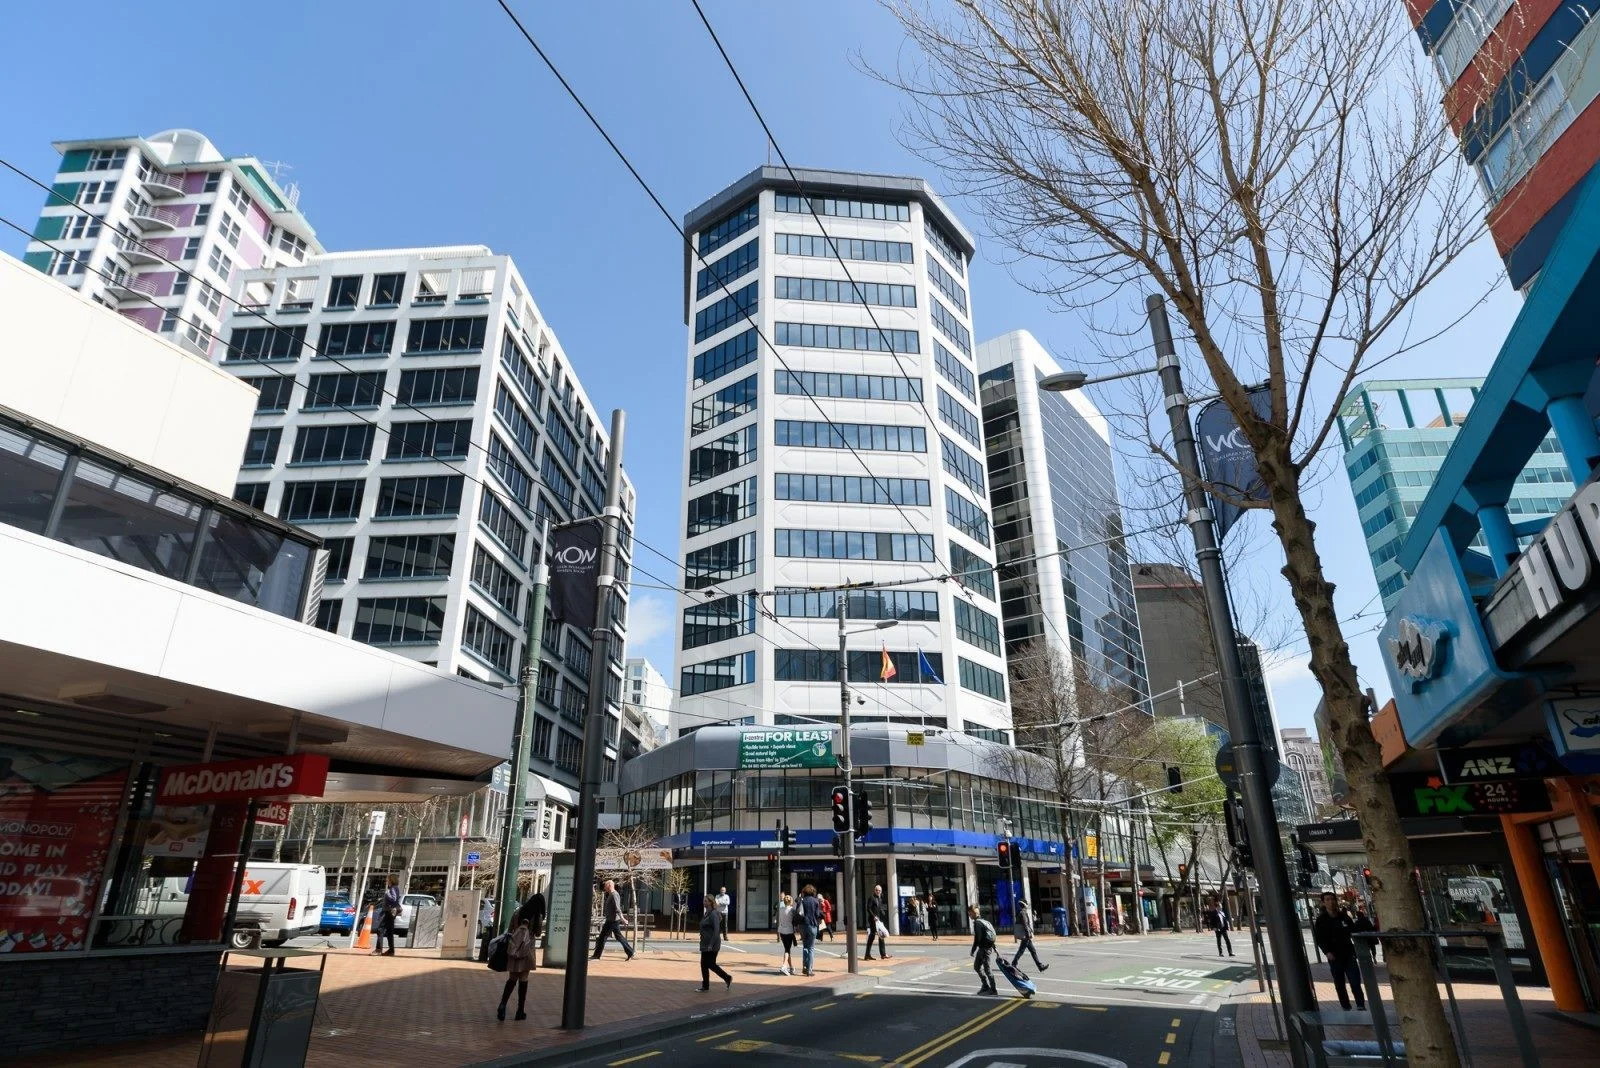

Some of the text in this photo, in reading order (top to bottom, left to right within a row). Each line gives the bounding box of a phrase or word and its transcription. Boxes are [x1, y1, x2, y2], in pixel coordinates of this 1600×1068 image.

[1205, 426, 1252, 453] WO
[765, 732, 793, 742] FOR
[1460, 756, 1516, 777] ANZ
[162, 762, 294, 797] McDonald's
[1484, 783, 1506, 797] 24
[257, 802, 287, 821] ald's
[0, 840, 68, 858] OME IN
[23, 862, 68, 878] PLAY
[0, 881, 52, 896] ODAY!
[1142, 966, 1213, 978] BUS
[1100, 975, 1202, 989] ONLY
